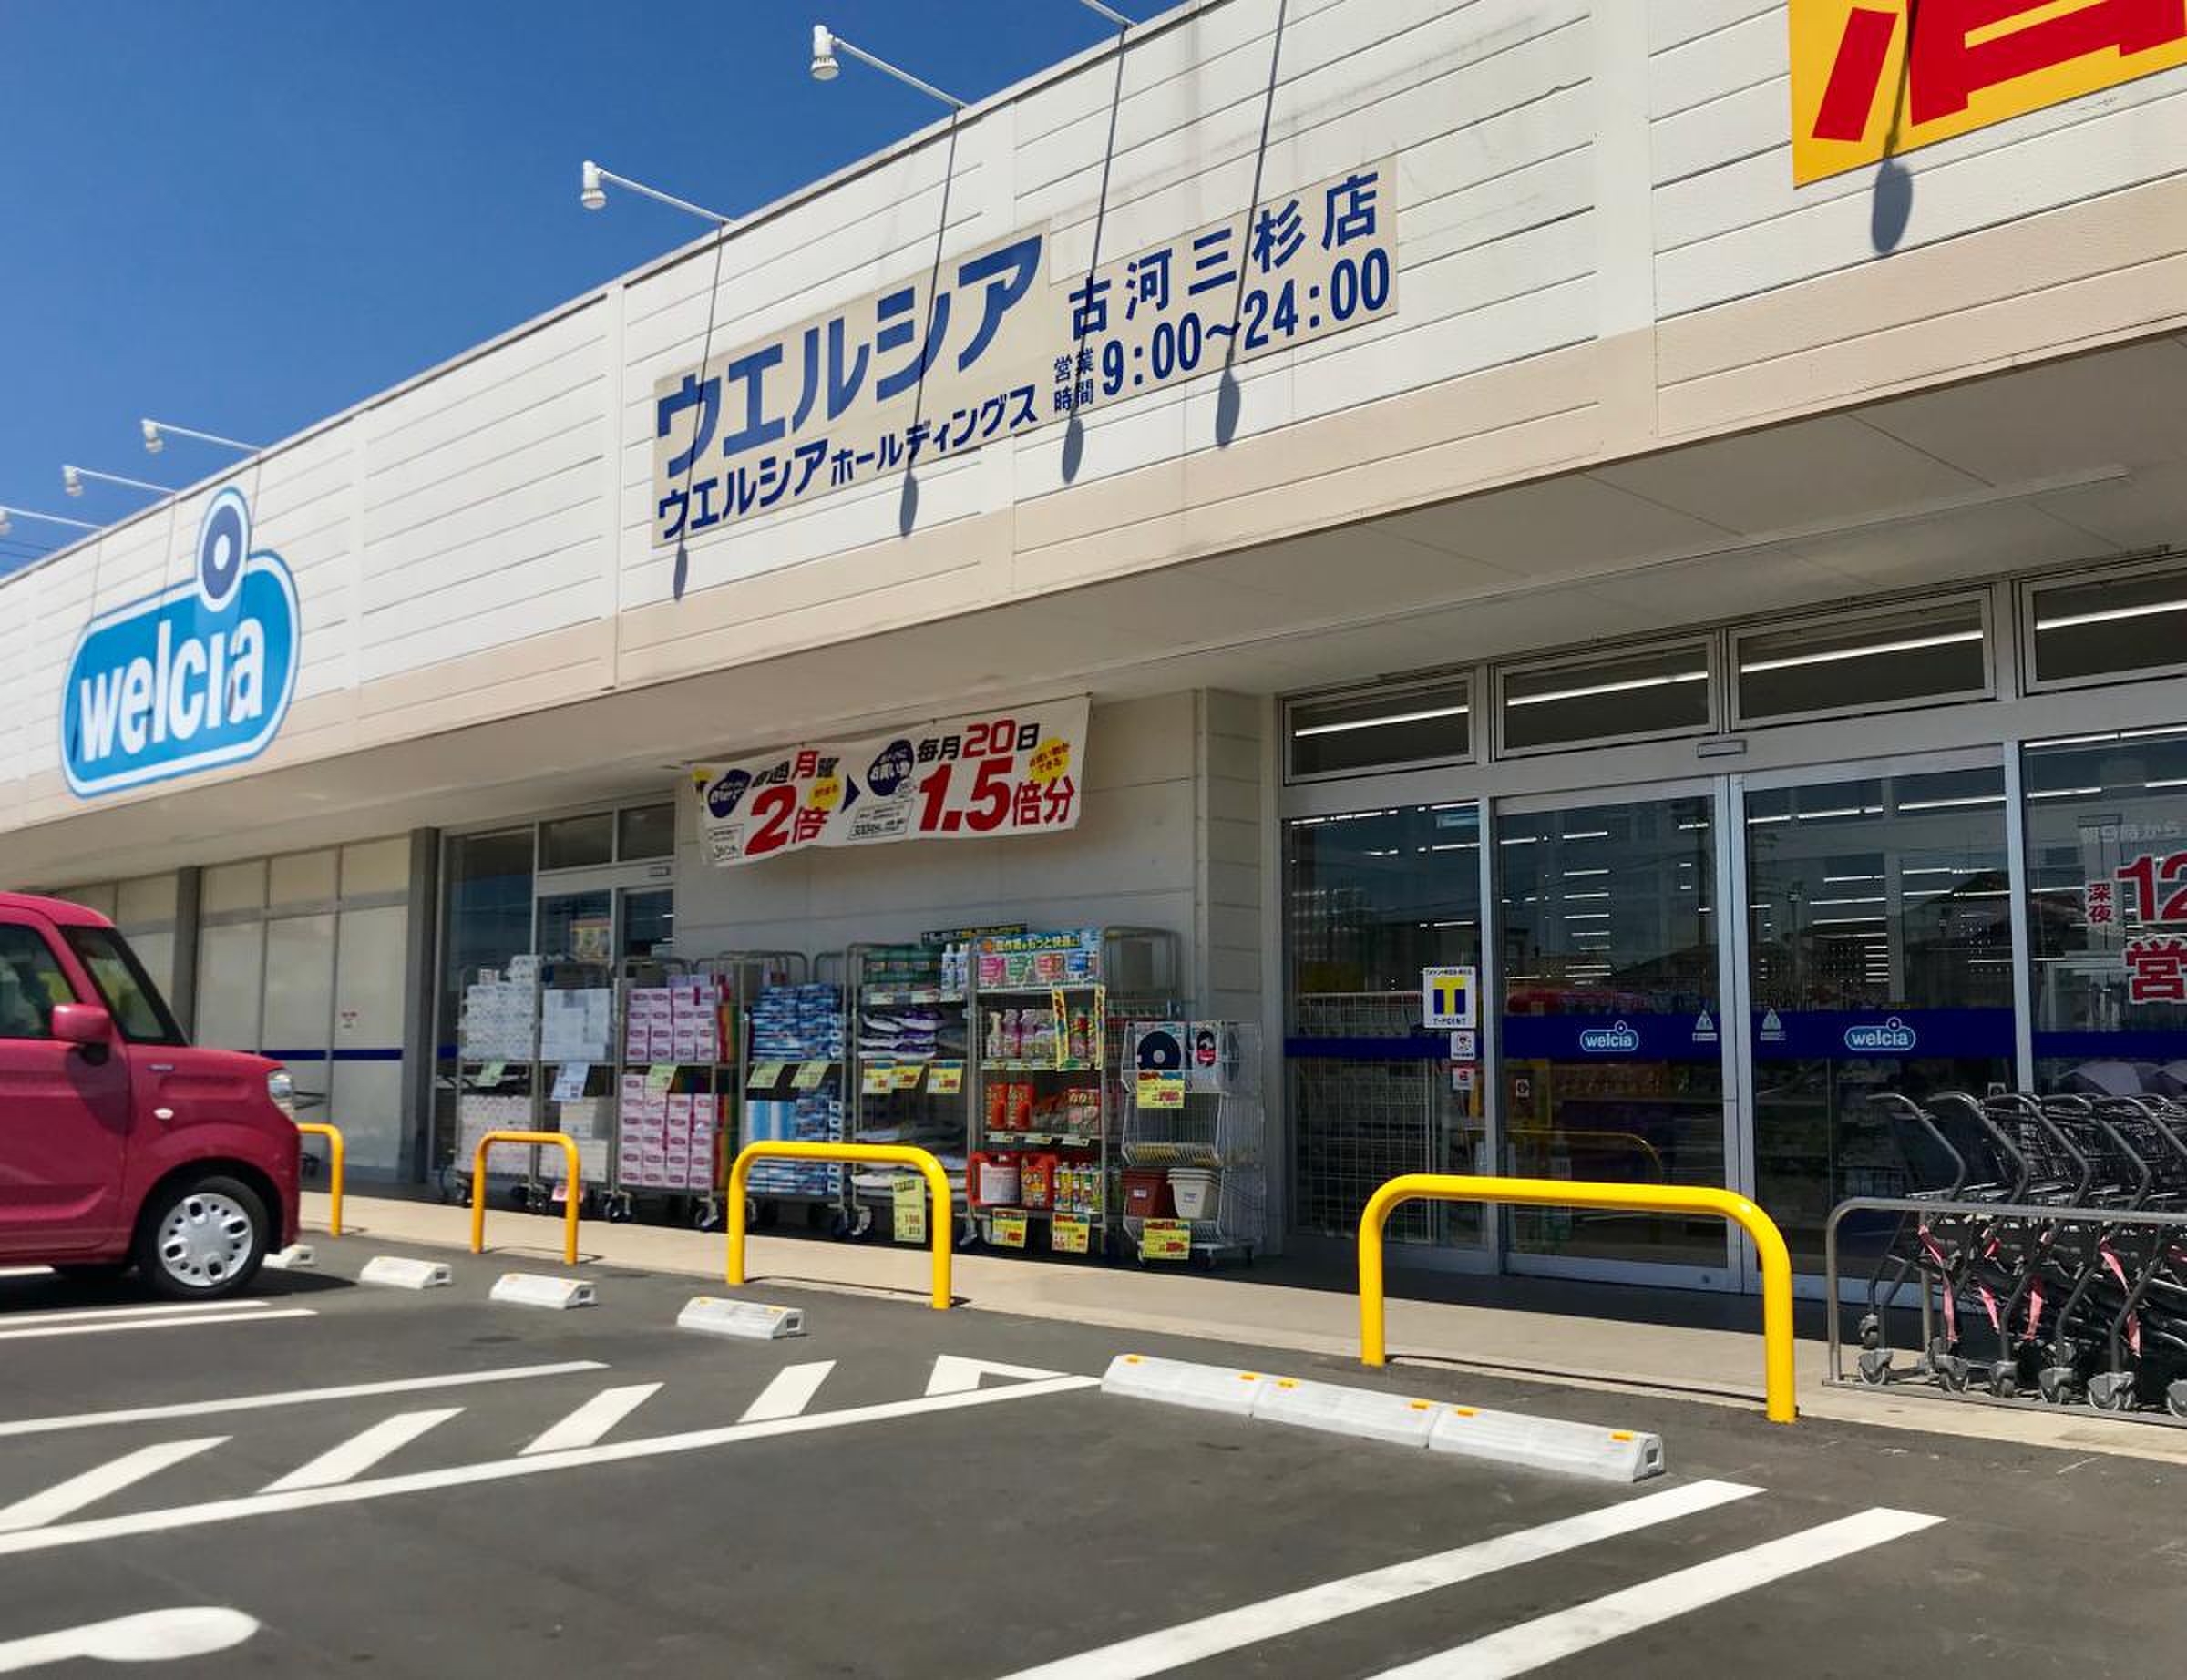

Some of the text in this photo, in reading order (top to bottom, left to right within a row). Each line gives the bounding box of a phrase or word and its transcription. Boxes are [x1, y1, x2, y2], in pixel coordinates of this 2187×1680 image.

[1069, 171, 1380, 341] 古河三杉店
[657, 234, 1044, 478] ウエルシア
[1054, 348, 1094, 384] 営業
[1054, 381, 1094, 411] 時間
[80, 617, 265, 763] welcia
[918, 718, 1040, 763] 毎月20日
[918, 756, 1076, 832] 1.5倍分
[744, 784, 832, 855] 2倍
[2088, 882, 2113, 924] 深夜
[1585, 1032, 1634, 1049] welcia
[1851, 1030, 1910, 1048] welcia
